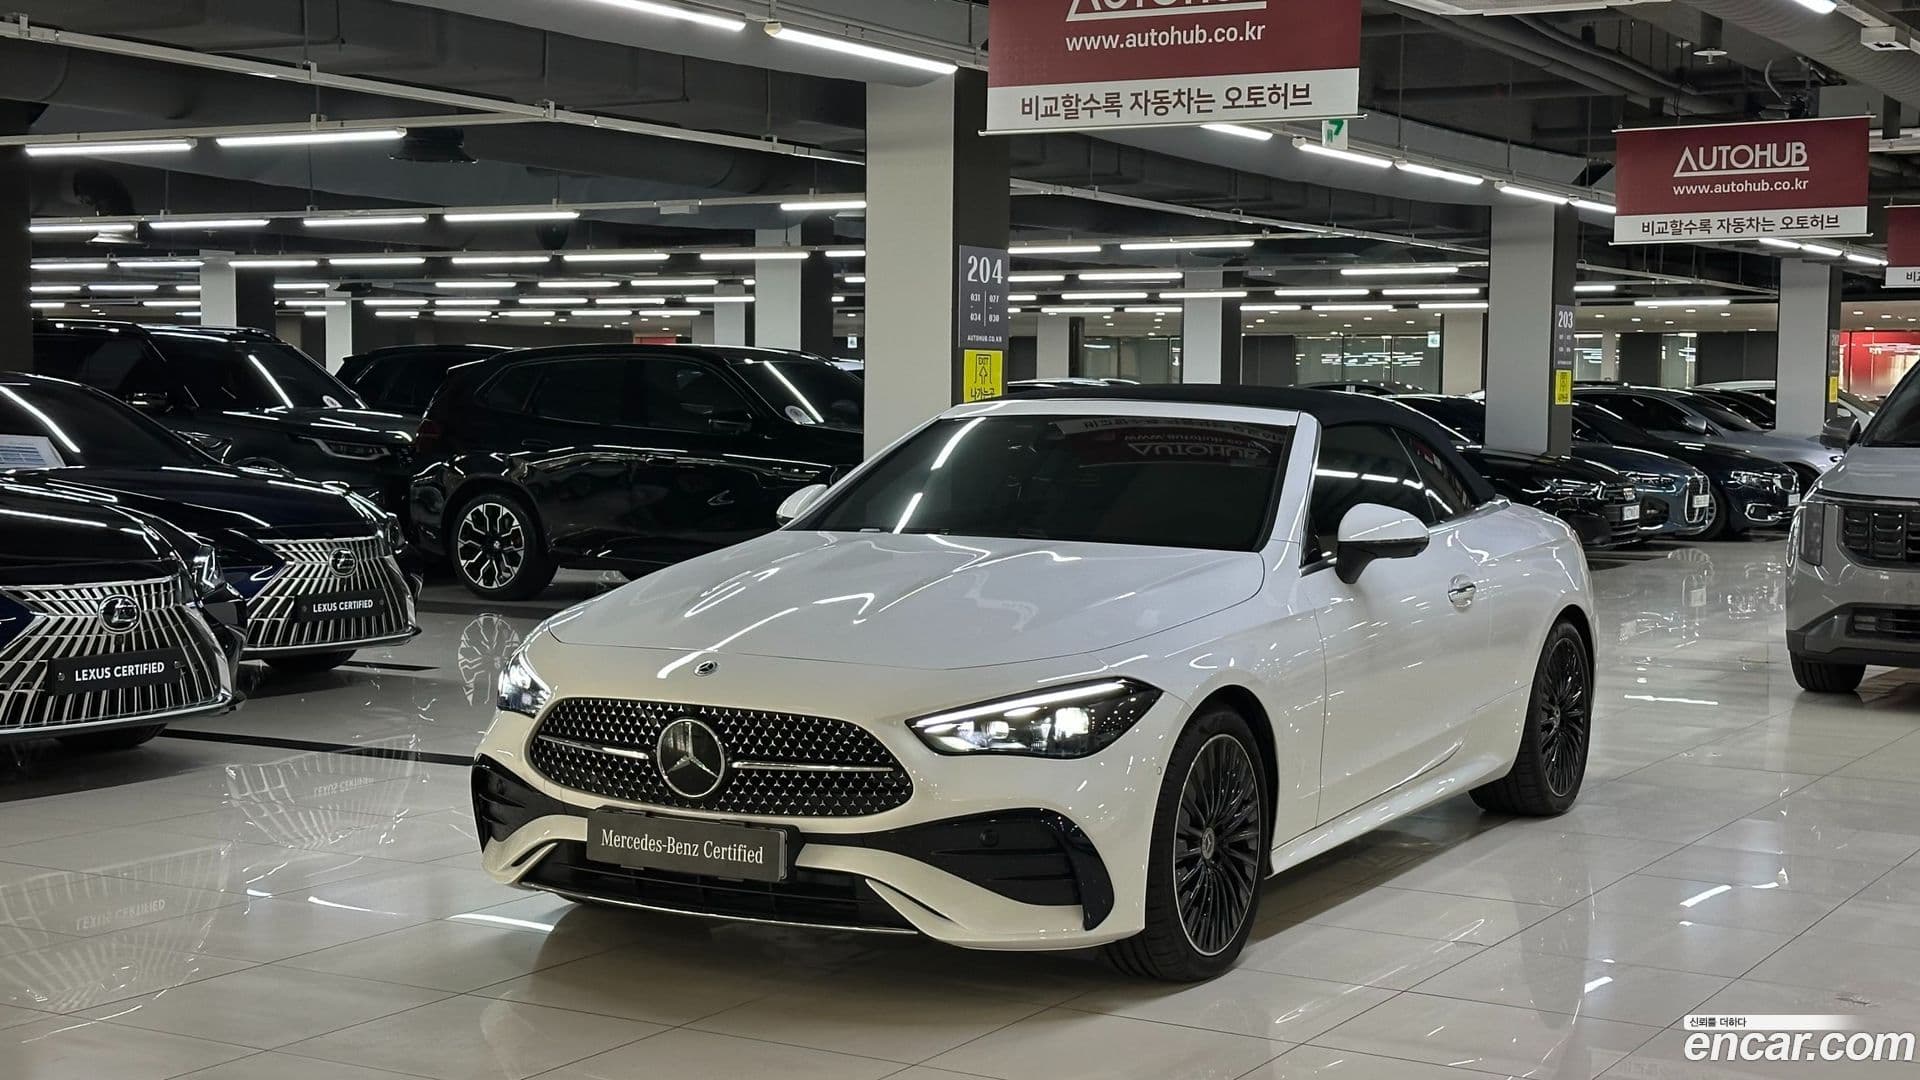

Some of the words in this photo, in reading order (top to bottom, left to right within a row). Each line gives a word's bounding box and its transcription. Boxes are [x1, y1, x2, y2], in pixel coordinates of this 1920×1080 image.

[1066, 21, 1265, 51] www.autohub.co.kr
[1021, 91, 1123, 121] 비교할수록
[1129, 87, 1216, 117] 자동차는
[1222, 82, 1313, 110] 오토허브
[1673, 142, 1809, 177] AUTOHUB
[1673, 177, 1808, 195] www.autohub.co.kr
[1641, 219, 1712, 236] 비교할수록
[1716, 216, 1775, 233] 자동차는
[1779, 214, 1840, 230] 오토허브
[967, 255, 1003, 284] 204
[1558, 311, 1573, 328] 203
[313, 602, 337, 613] LEXUS
[338, 599, 374, 611] CERTIFIED
[75, 667, 111, 681] LEXUS
[113, 662, 165, 678] CERTIFIED
[601, 828, 699, 857] Mercedes-Benz
[703, 841, 763, 864] Certified
